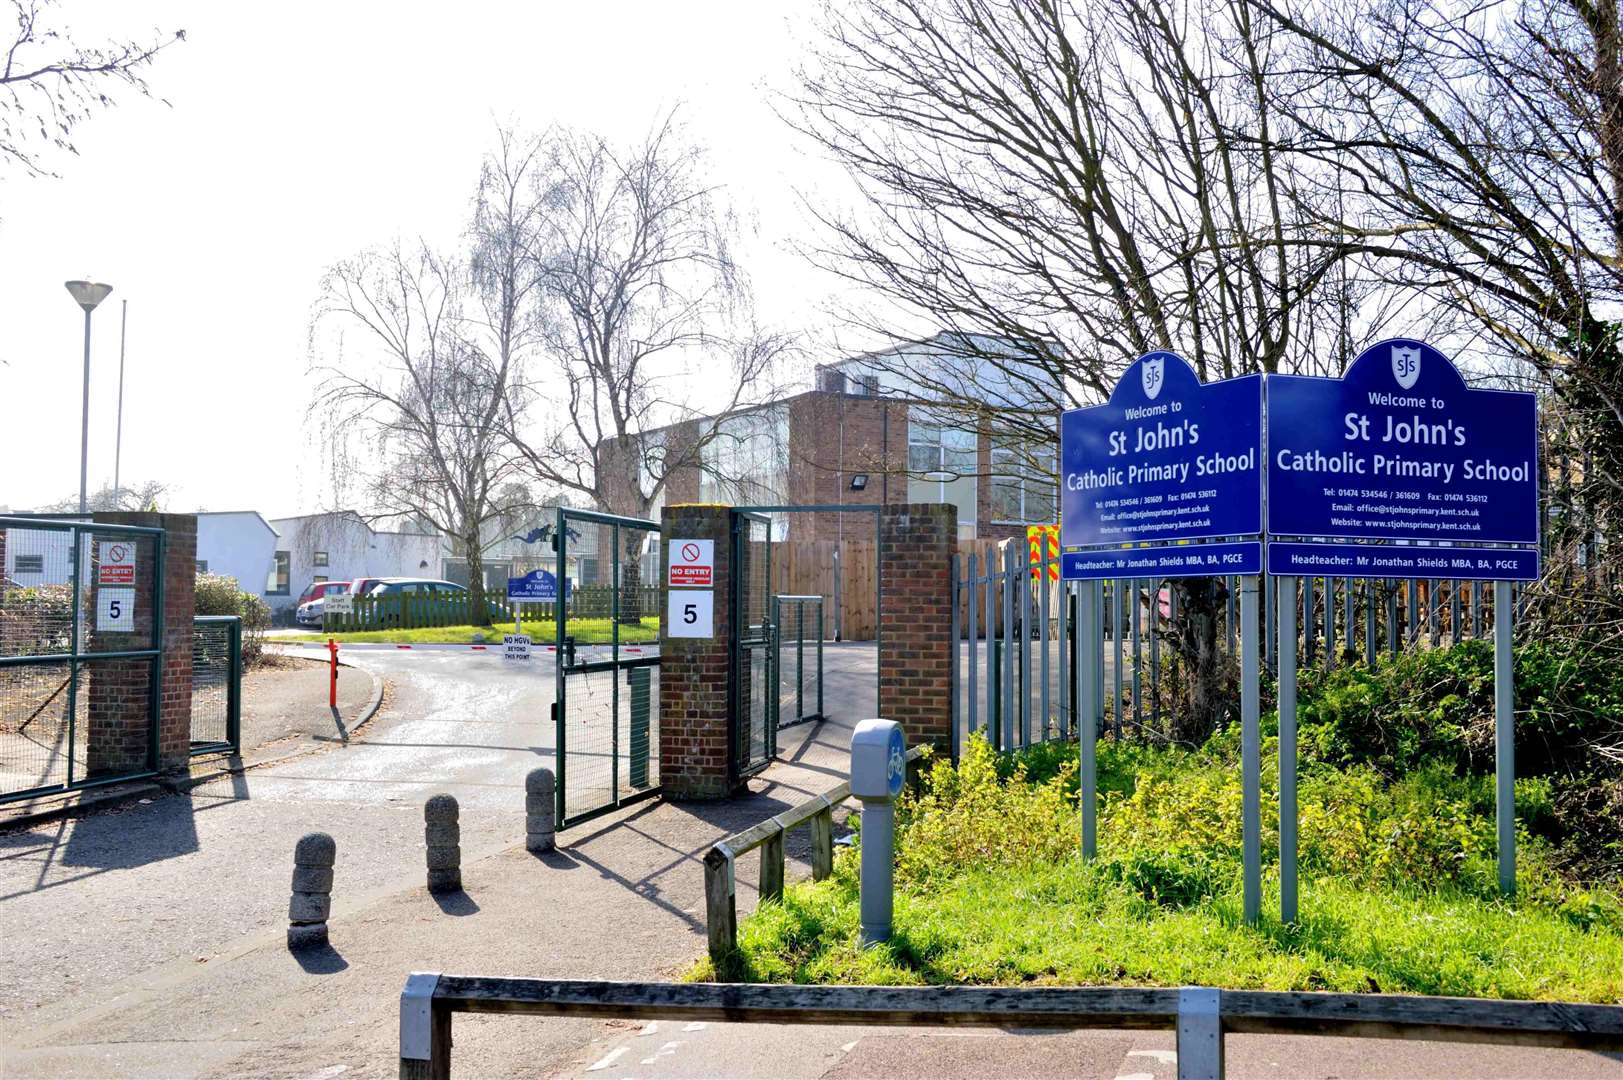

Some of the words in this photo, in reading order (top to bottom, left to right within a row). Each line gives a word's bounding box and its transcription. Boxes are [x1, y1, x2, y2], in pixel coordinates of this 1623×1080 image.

[1368, 392, 1426, 408] Welcome
[1432, 397, 1444, 409] to
[1125, 403, 1167, 420] Welcome
[1172, 401, 1182, 412] to
[1109, 430, 1126, 456] St
[1135, 419, 1199, 453] John's
[1344, 412, 1370, 441] St
[1382, 415, 1466, 446] John's
[1067, 467, 1123, 491] Catholic
[1129, 462, 1189, 484] Primary
[1196, 448, 1254, 476] School
[1277, 449, 1366, 474] Catholic
[1374, 454, 1454, 484] Primary
[1463, 459, 1529, 482] School
[1324, 488, 1335, 496] Tel:
[1338, 489, 1358, 497] 01474
[1361, 490, 1388, 498] 534546
[1395, 491, 1420, 500] 361609
[1466, 494, 1487, 502] 536112
[1332, 504, 1354, 512] Email:
[1356, 505, 1479, 516] office@stjohnsprimary.kent.sch.uk
[1331, 518, 1362, 526] Website:
[1365, 520, 1480, 531] www.stjohnsprimary.kent.sch.uk
[1075, 561, 1114, 570] Headteacher:
[1117, 560, 1125, 568] Mr
[1127, 558, 1157, 568] Jonathan
[1159, 556, 1184, 566] Shields
[1186, 556, 1204, 566] MBA,
[1207, 555, 1220, 565] BA,
[1223, 554, 1243, 563] PGCE
[1291, 554, 1353, 566] Headteacher:
[1356, 556, 1369, 566] Mr
[1372, 557, 1414, 567] Jonathan
[1417, 558, 1448, 568] Shields
[1451, 559, 1474, 570] MBA,
[1478, 560, 1492, 570] BA,
[1496, 560, 1518, 570] PGCE
[110, 601, 120, 618] 5
[684, 605, 697, 624] 5
